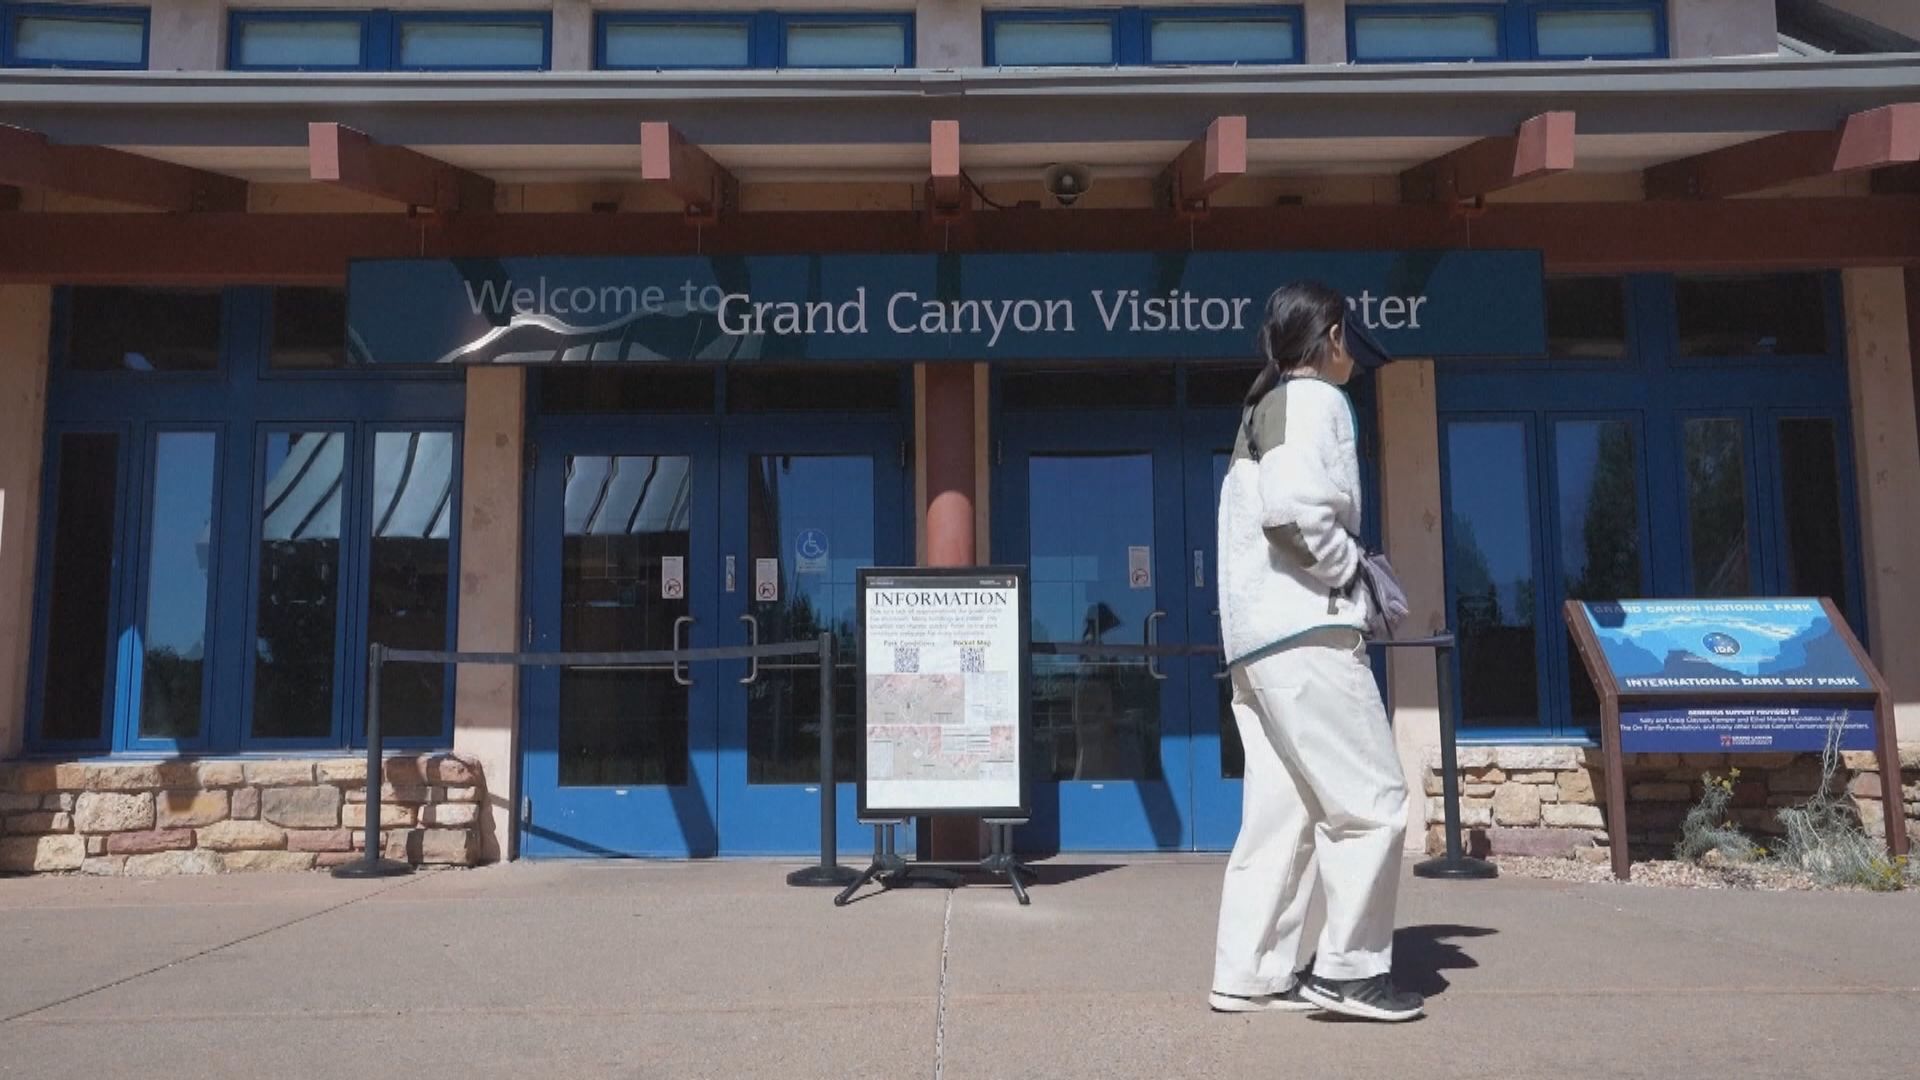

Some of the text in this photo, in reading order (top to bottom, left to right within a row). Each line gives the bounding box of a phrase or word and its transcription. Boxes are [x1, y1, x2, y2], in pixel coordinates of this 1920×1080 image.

[464, 276, 726, 315] Welcome to
[717, 286, 1428, 348] Grand Canyon Visitor ter
[874, 591, 1008, 606] INFORMATION
[1594, 603, 1813, 613] GRAND CANYON NATIONAL PARK
[1714, 645, 1736, 654] IDA
[1625, 676, 1860, 688] INTERNATIONAL DARK SKY PARK
